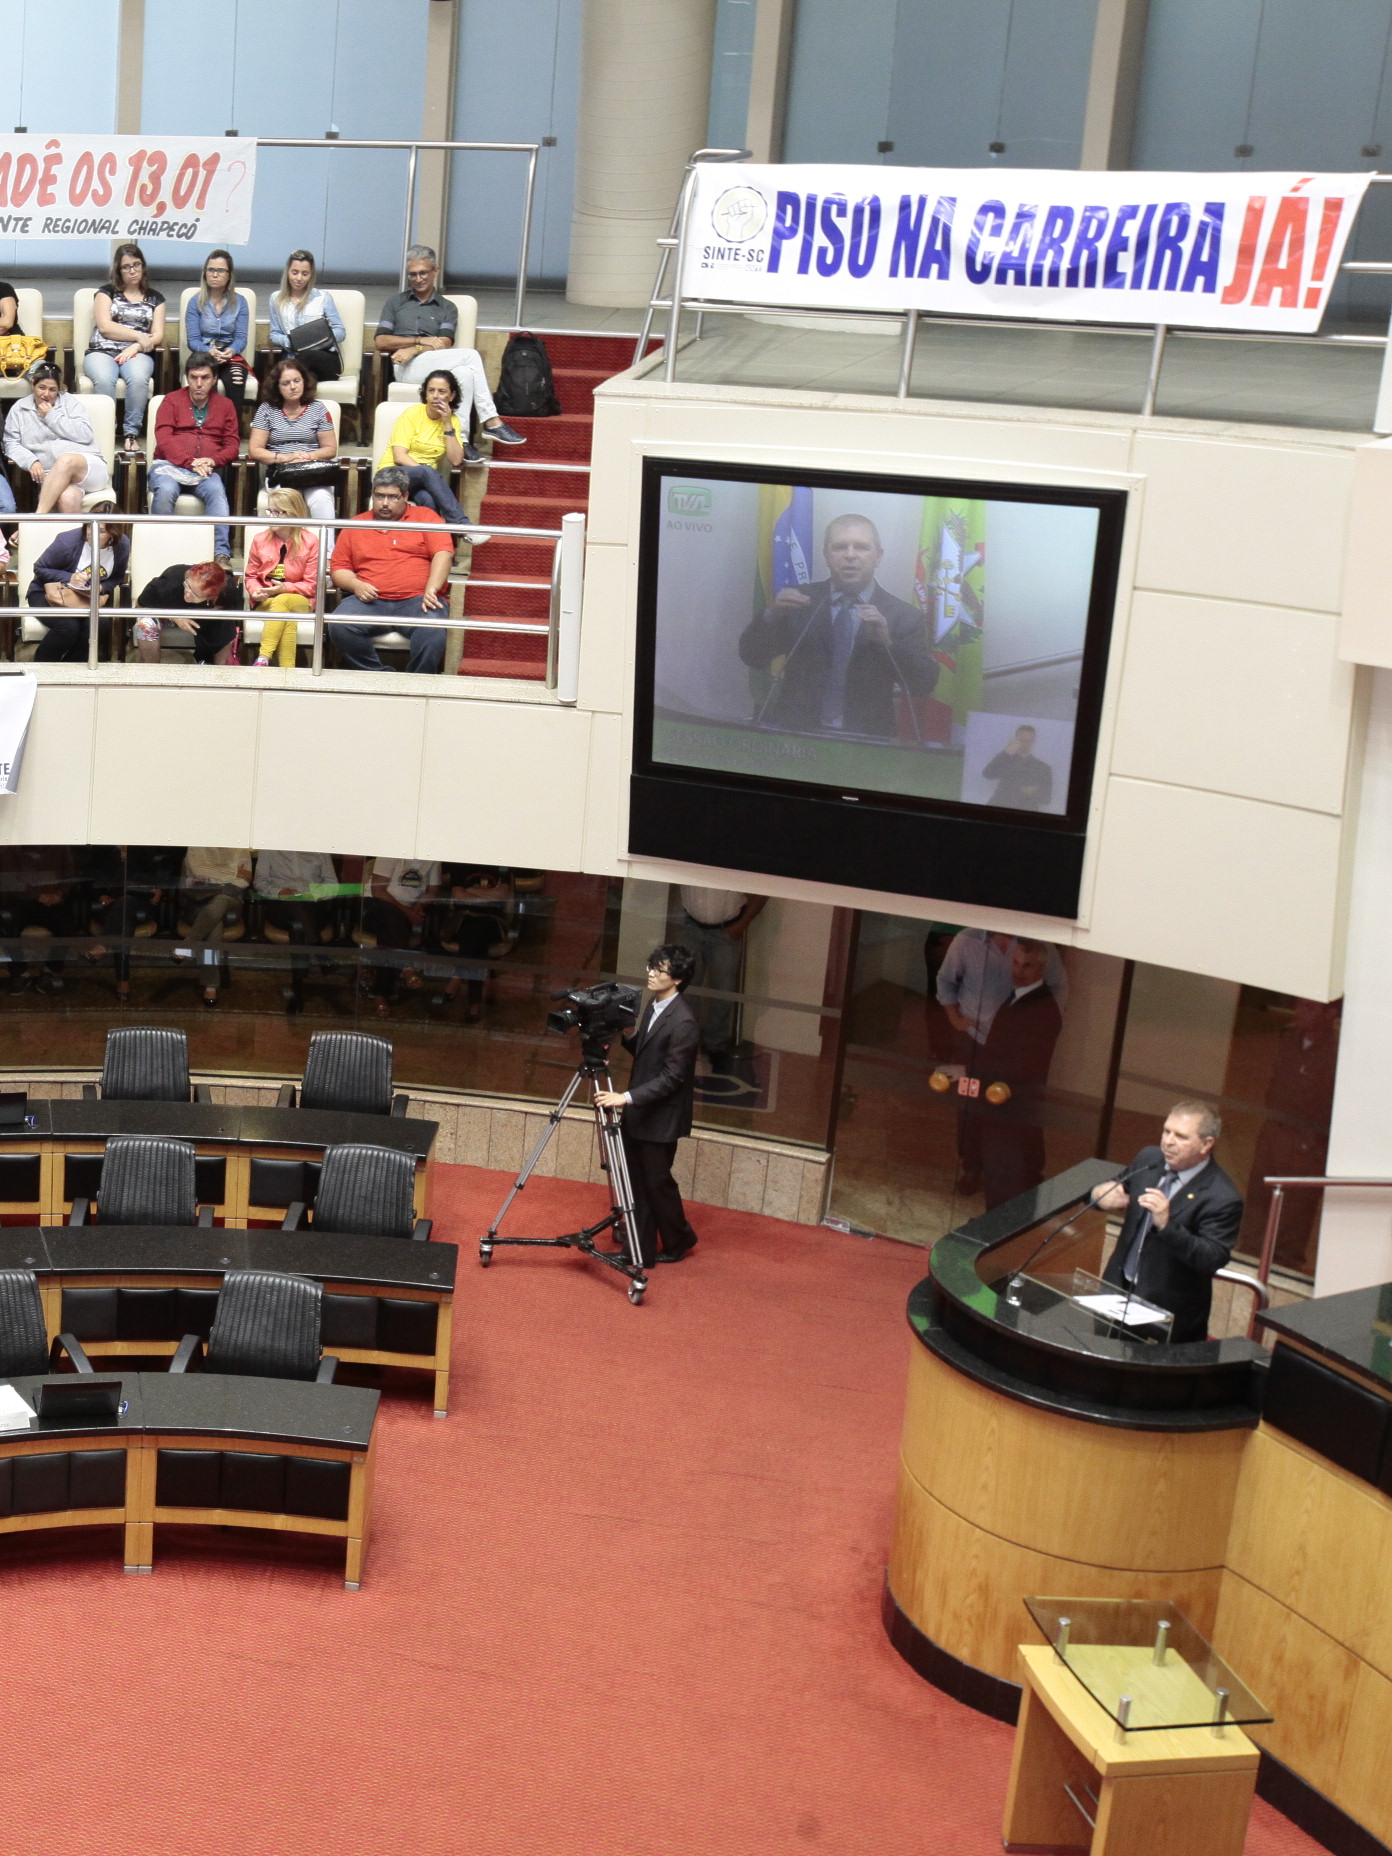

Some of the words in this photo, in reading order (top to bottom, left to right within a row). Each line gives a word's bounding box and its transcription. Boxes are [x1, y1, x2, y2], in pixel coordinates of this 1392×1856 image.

[68, 151, 118, 209] OS
[124, 148, 220, 220] 13,01
[41, 217, 120, 236] REGIONAL
[127, 217, 199, 241] CHAPECÓ
[703, 245, 765, 263] SINTE-SC
[766, 188, 881, 280] PISO
[888, 193, 959, 282] NA
[964, 198, 1226, 295] CARREIRA
[1219, 176, 1346, 311] JÁ!
[666, 520, 683, 530] AO
[684, 522, 713, 533] VIVO
